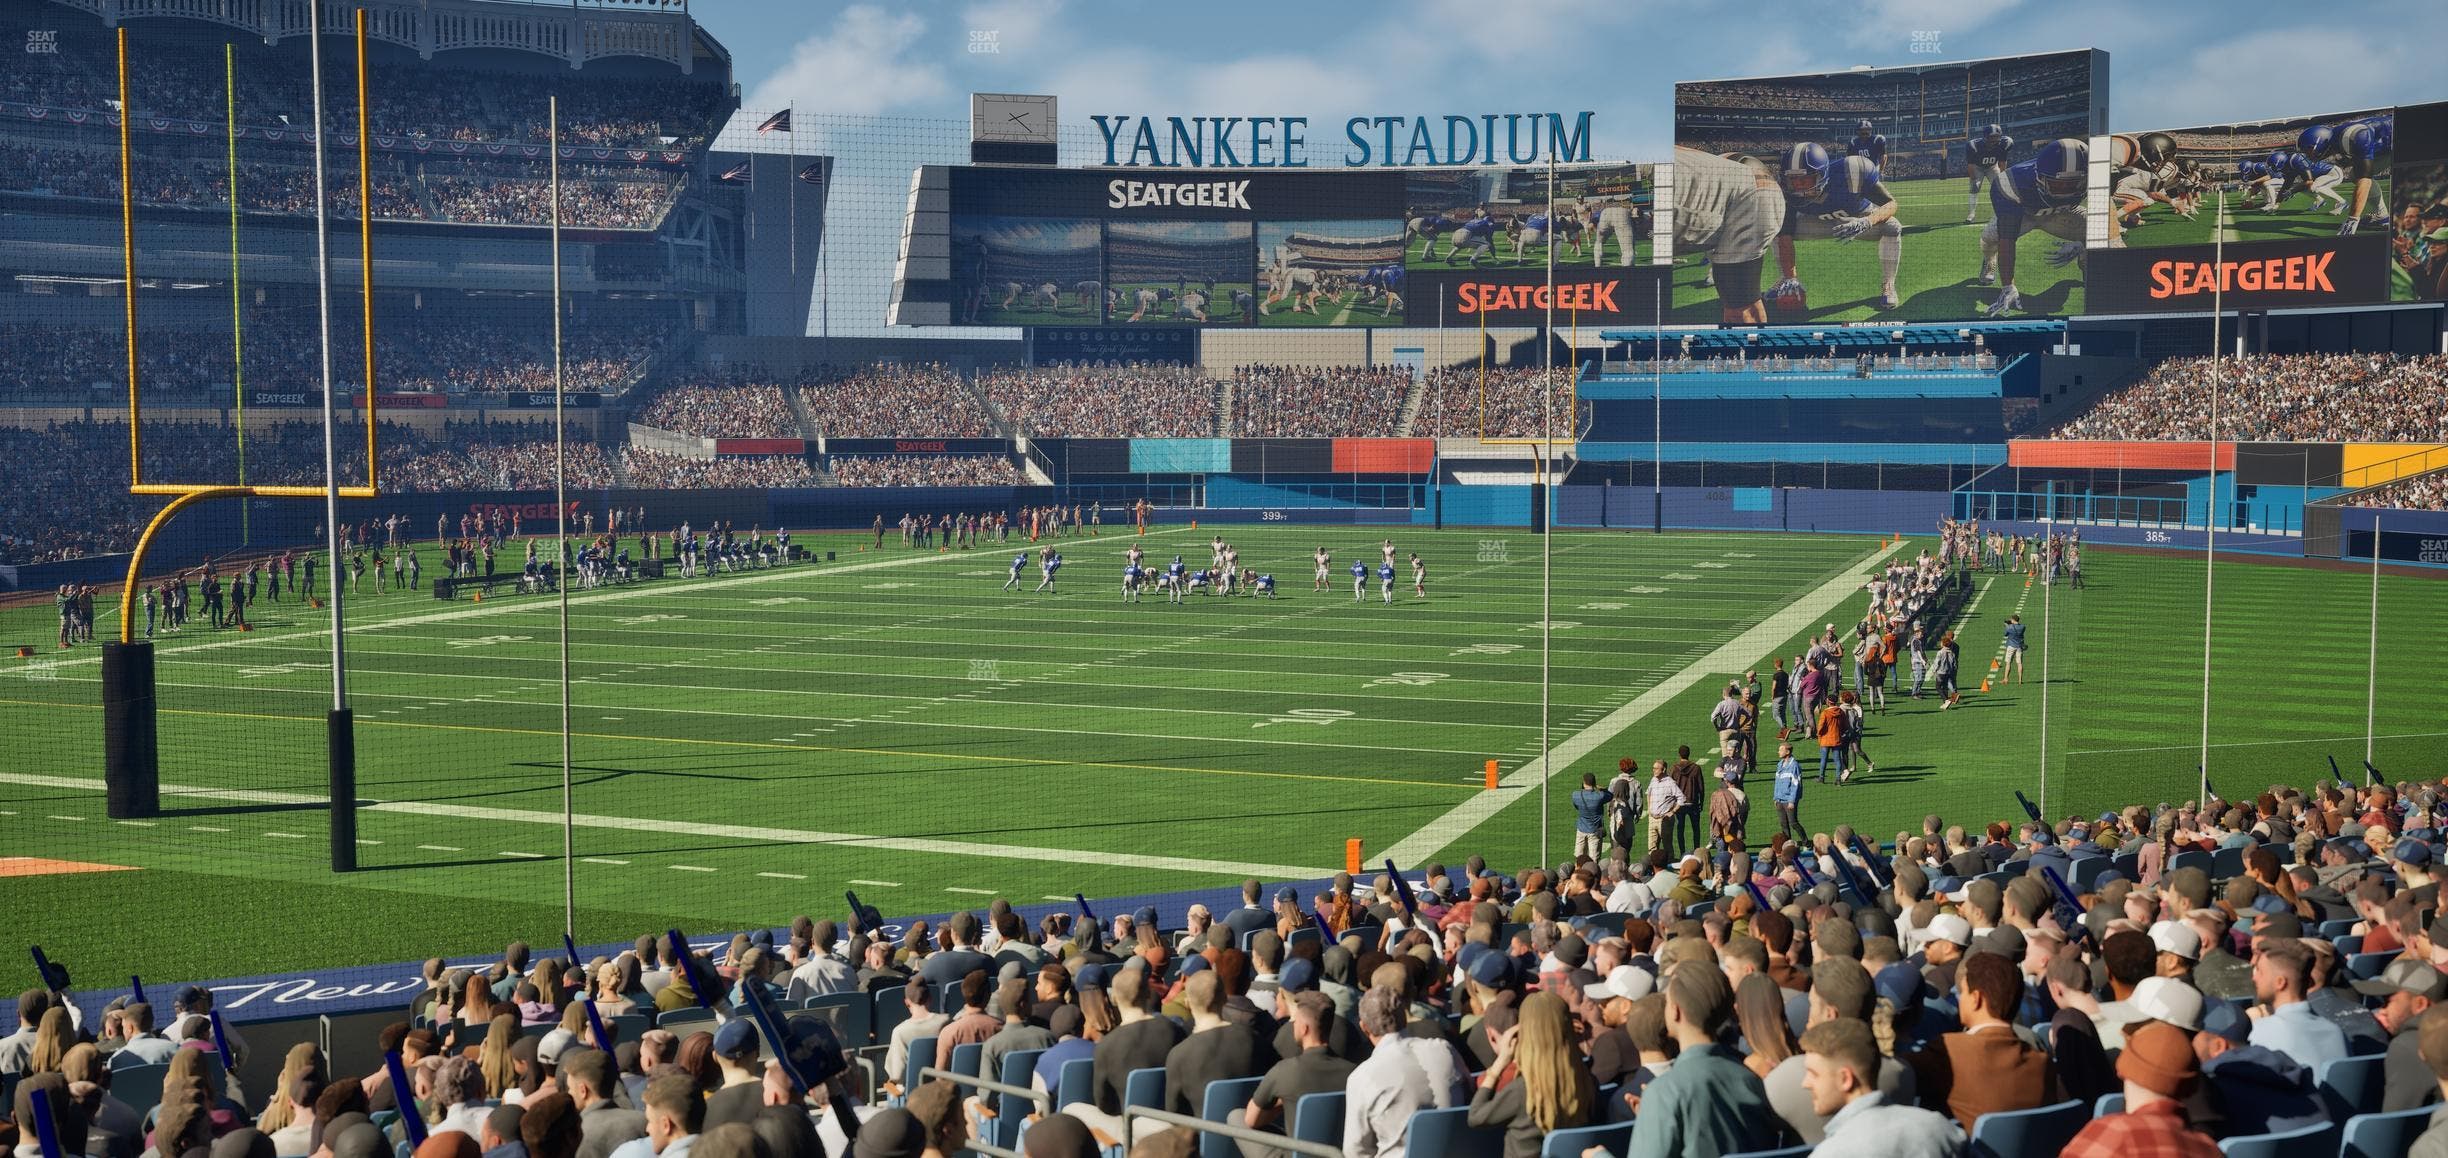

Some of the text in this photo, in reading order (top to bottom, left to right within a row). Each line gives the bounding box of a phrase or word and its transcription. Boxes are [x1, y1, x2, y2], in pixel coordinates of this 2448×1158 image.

[1090, 111, 1595, 168] YANKEE STADIUM
[1108, 179, 1251, 210] SEATGEEK
[2150, 251, 2336, 299] SEATGEEK
[1458, 280, 1620, 314] SEATGEEK
[255, 393, 305, 404] SEATGEEK
[529, 395, 578, 405] SEATGEK
[896, 441, 947, 451] SEATGEEK
